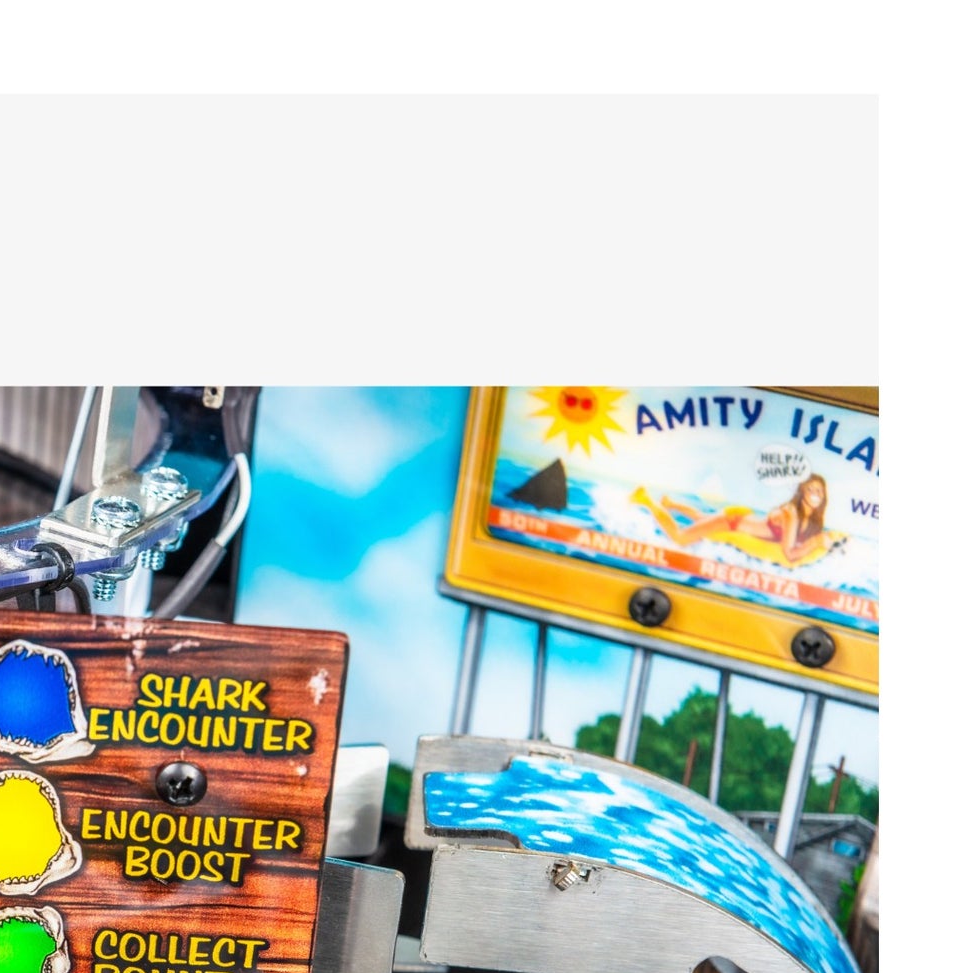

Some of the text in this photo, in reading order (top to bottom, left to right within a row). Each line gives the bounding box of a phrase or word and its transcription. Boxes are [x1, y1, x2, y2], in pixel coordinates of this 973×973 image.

[636, 396, 879, 476] AMITY ISLA
[576, 529, 669, 567] ANNUAL
[700, 560, 800, 598] REGATTA
[138, 674, 267, 711] SHARK
[88, 708, 313, 751] ENCOUNTER
[81, 809, 302, 850] ENCOUNTER
[125, 846, 251, 882] BOOST
[93, 930, 266, 968] COLLECT
